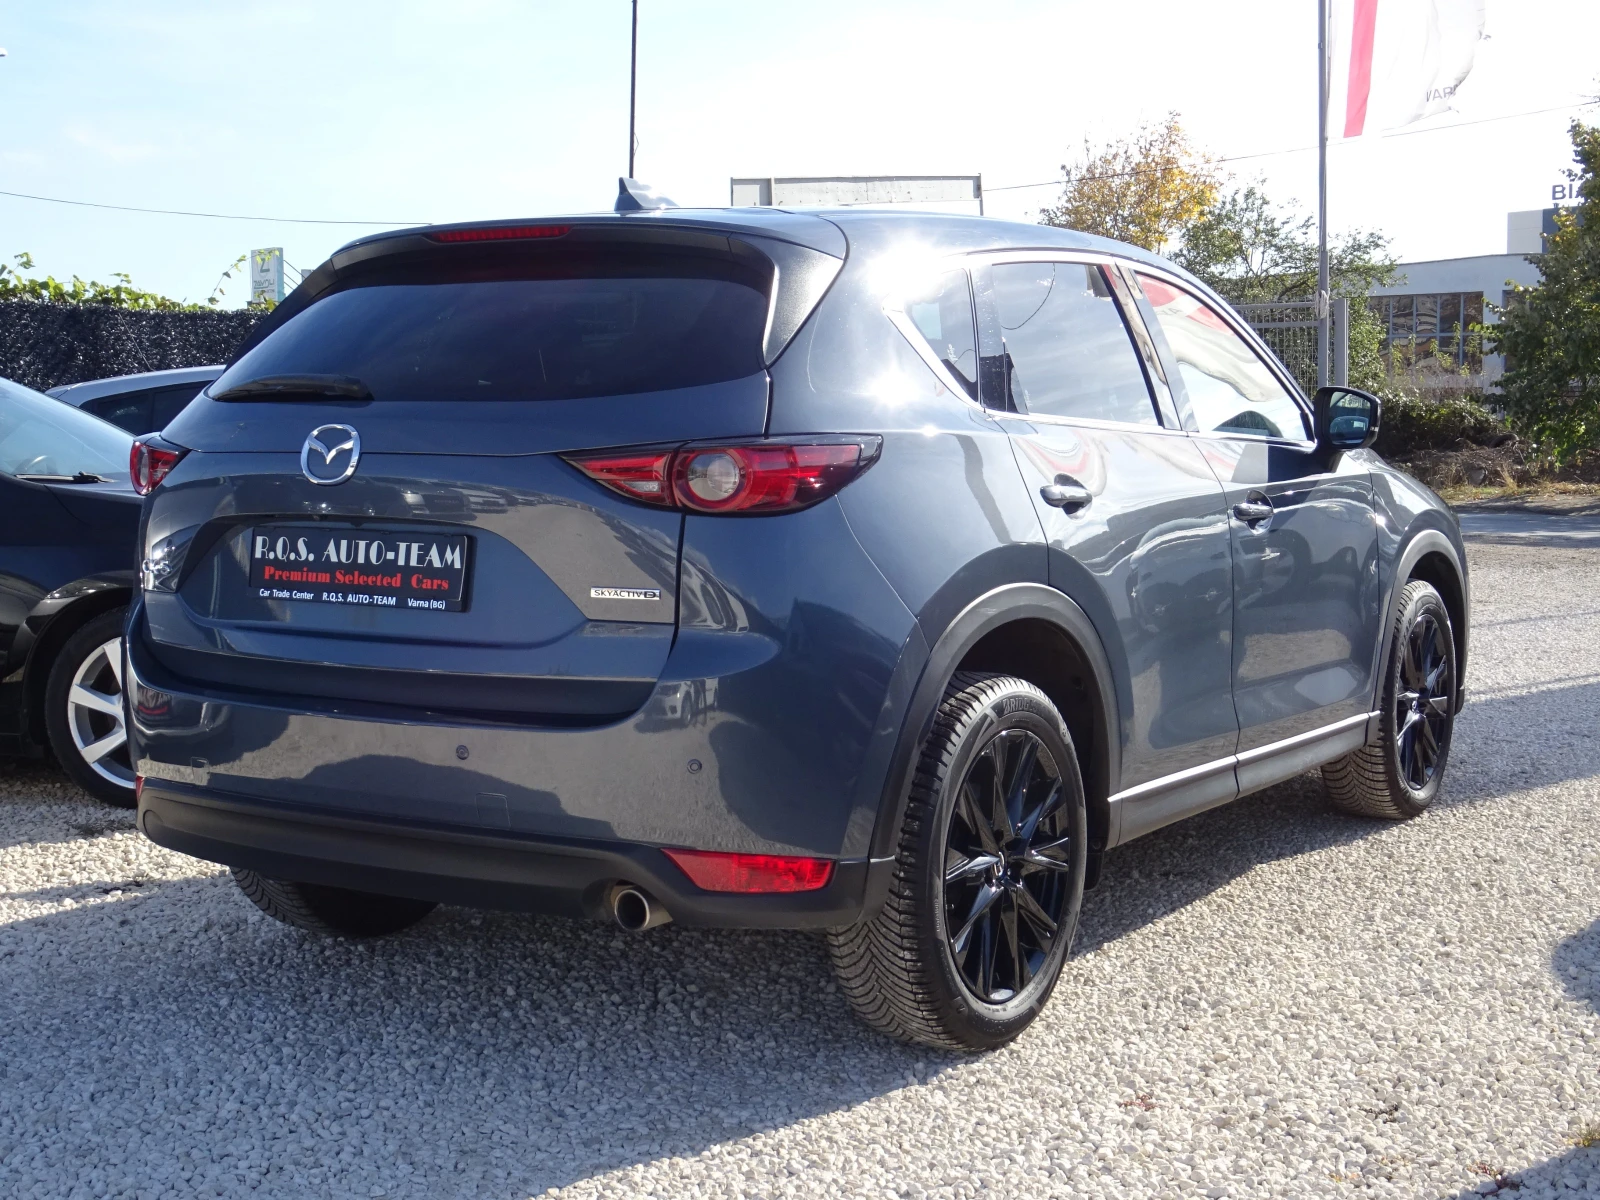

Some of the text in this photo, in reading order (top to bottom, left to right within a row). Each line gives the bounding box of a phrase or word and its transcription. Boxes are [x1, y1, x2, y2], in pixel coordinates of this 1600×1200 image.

[1552, 183, 1580, 200] BI
[254, 535, 461, 569] R.Q.S. AUTO-TEAM
[264, 565, 449, 591] Premium Selected Cars
[259, 588, 271, 598] Car
[272, 589, 290, 599] Trade
[292, 590, 314, 600] Center
[322, 592, 344, 603] R.Q.S.
[407, 597, 429, 609] Varna
[429, 599, 446, 610] (BG)
